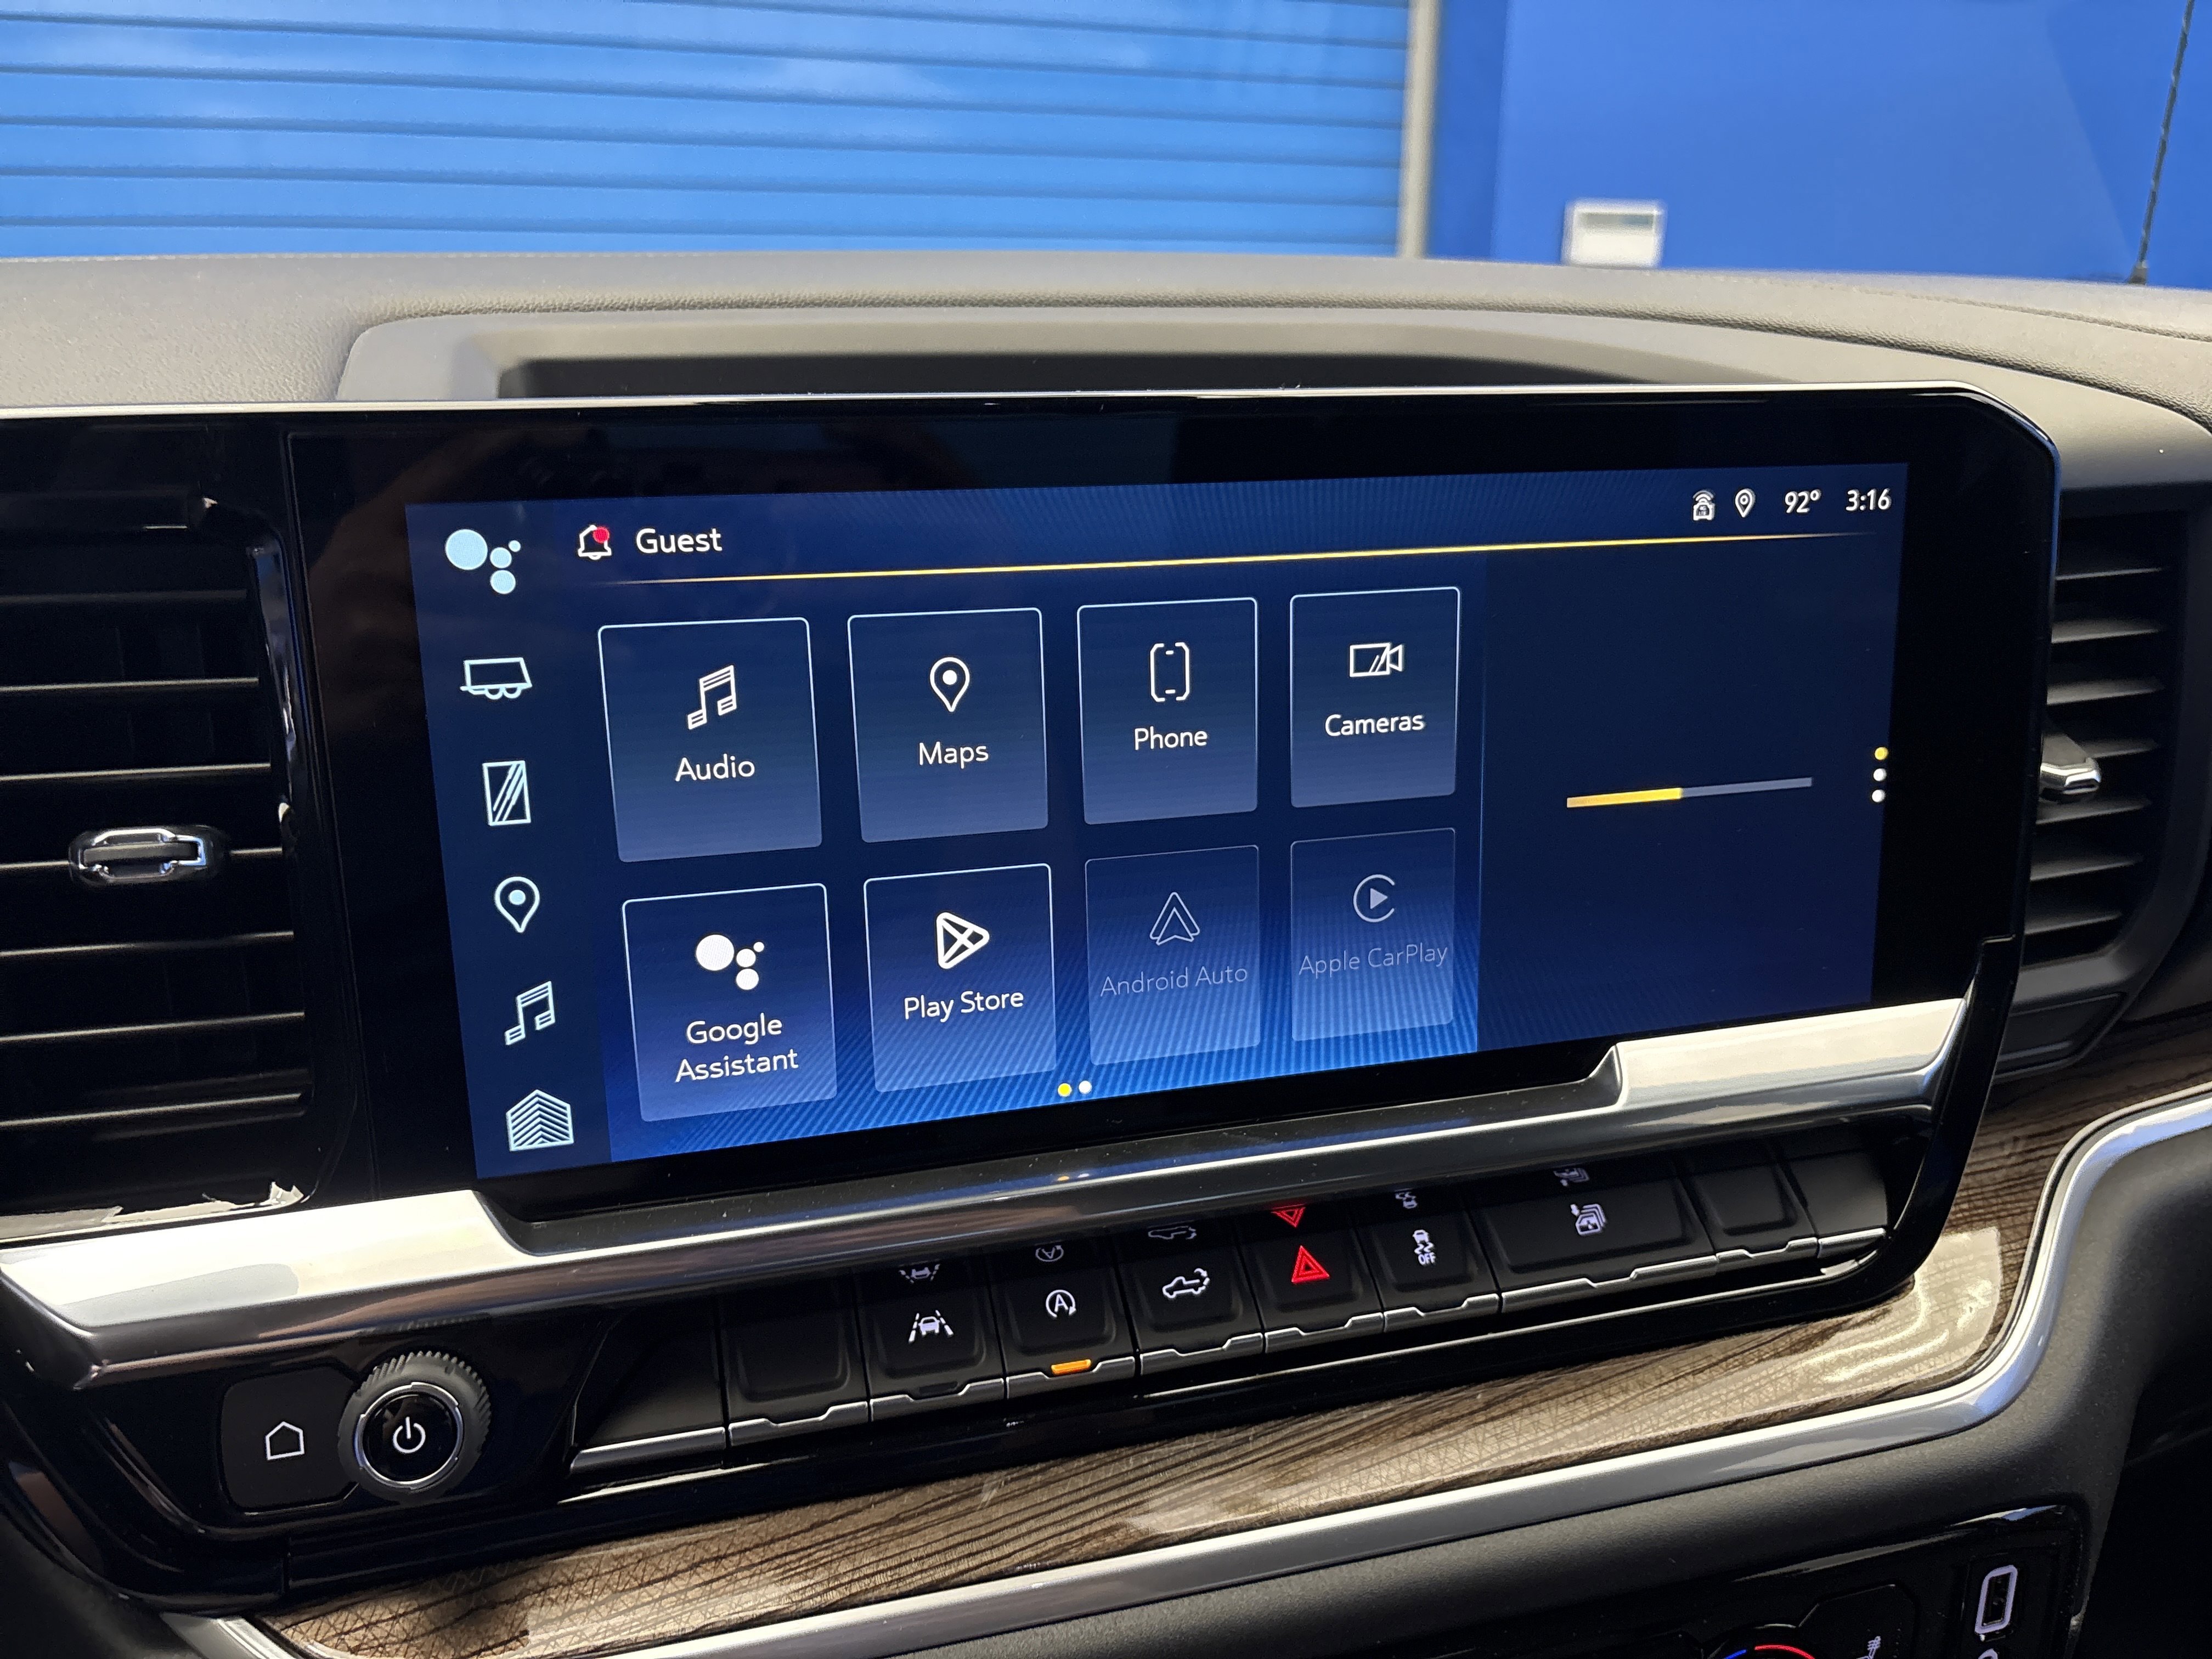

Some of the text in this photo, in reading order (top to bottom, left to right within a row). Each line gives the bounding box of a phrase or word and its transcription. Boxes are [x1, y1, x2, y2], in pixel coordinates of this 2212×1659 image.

[1846, 488, 1891, 511] 3:16
[636, 528, 723, 554] Guest
[1135, 726, 1207, 751] Phone
[1325, 714, 1425, 736] Cameras
[675, 753, 755, 782] Audio
[919, 741, 989, 769] Maps
[1298, 942, 1448, 979] Apple CarPlay
[1100, 966, 1248, 997] Android Auto
[904, 991, 1024, 1023] Play Store
[686, 1012, 782, 1045] Google
[675, 1048, 799, 1082] Assistant
[1418, 1252, 1436, 1266] OFF
